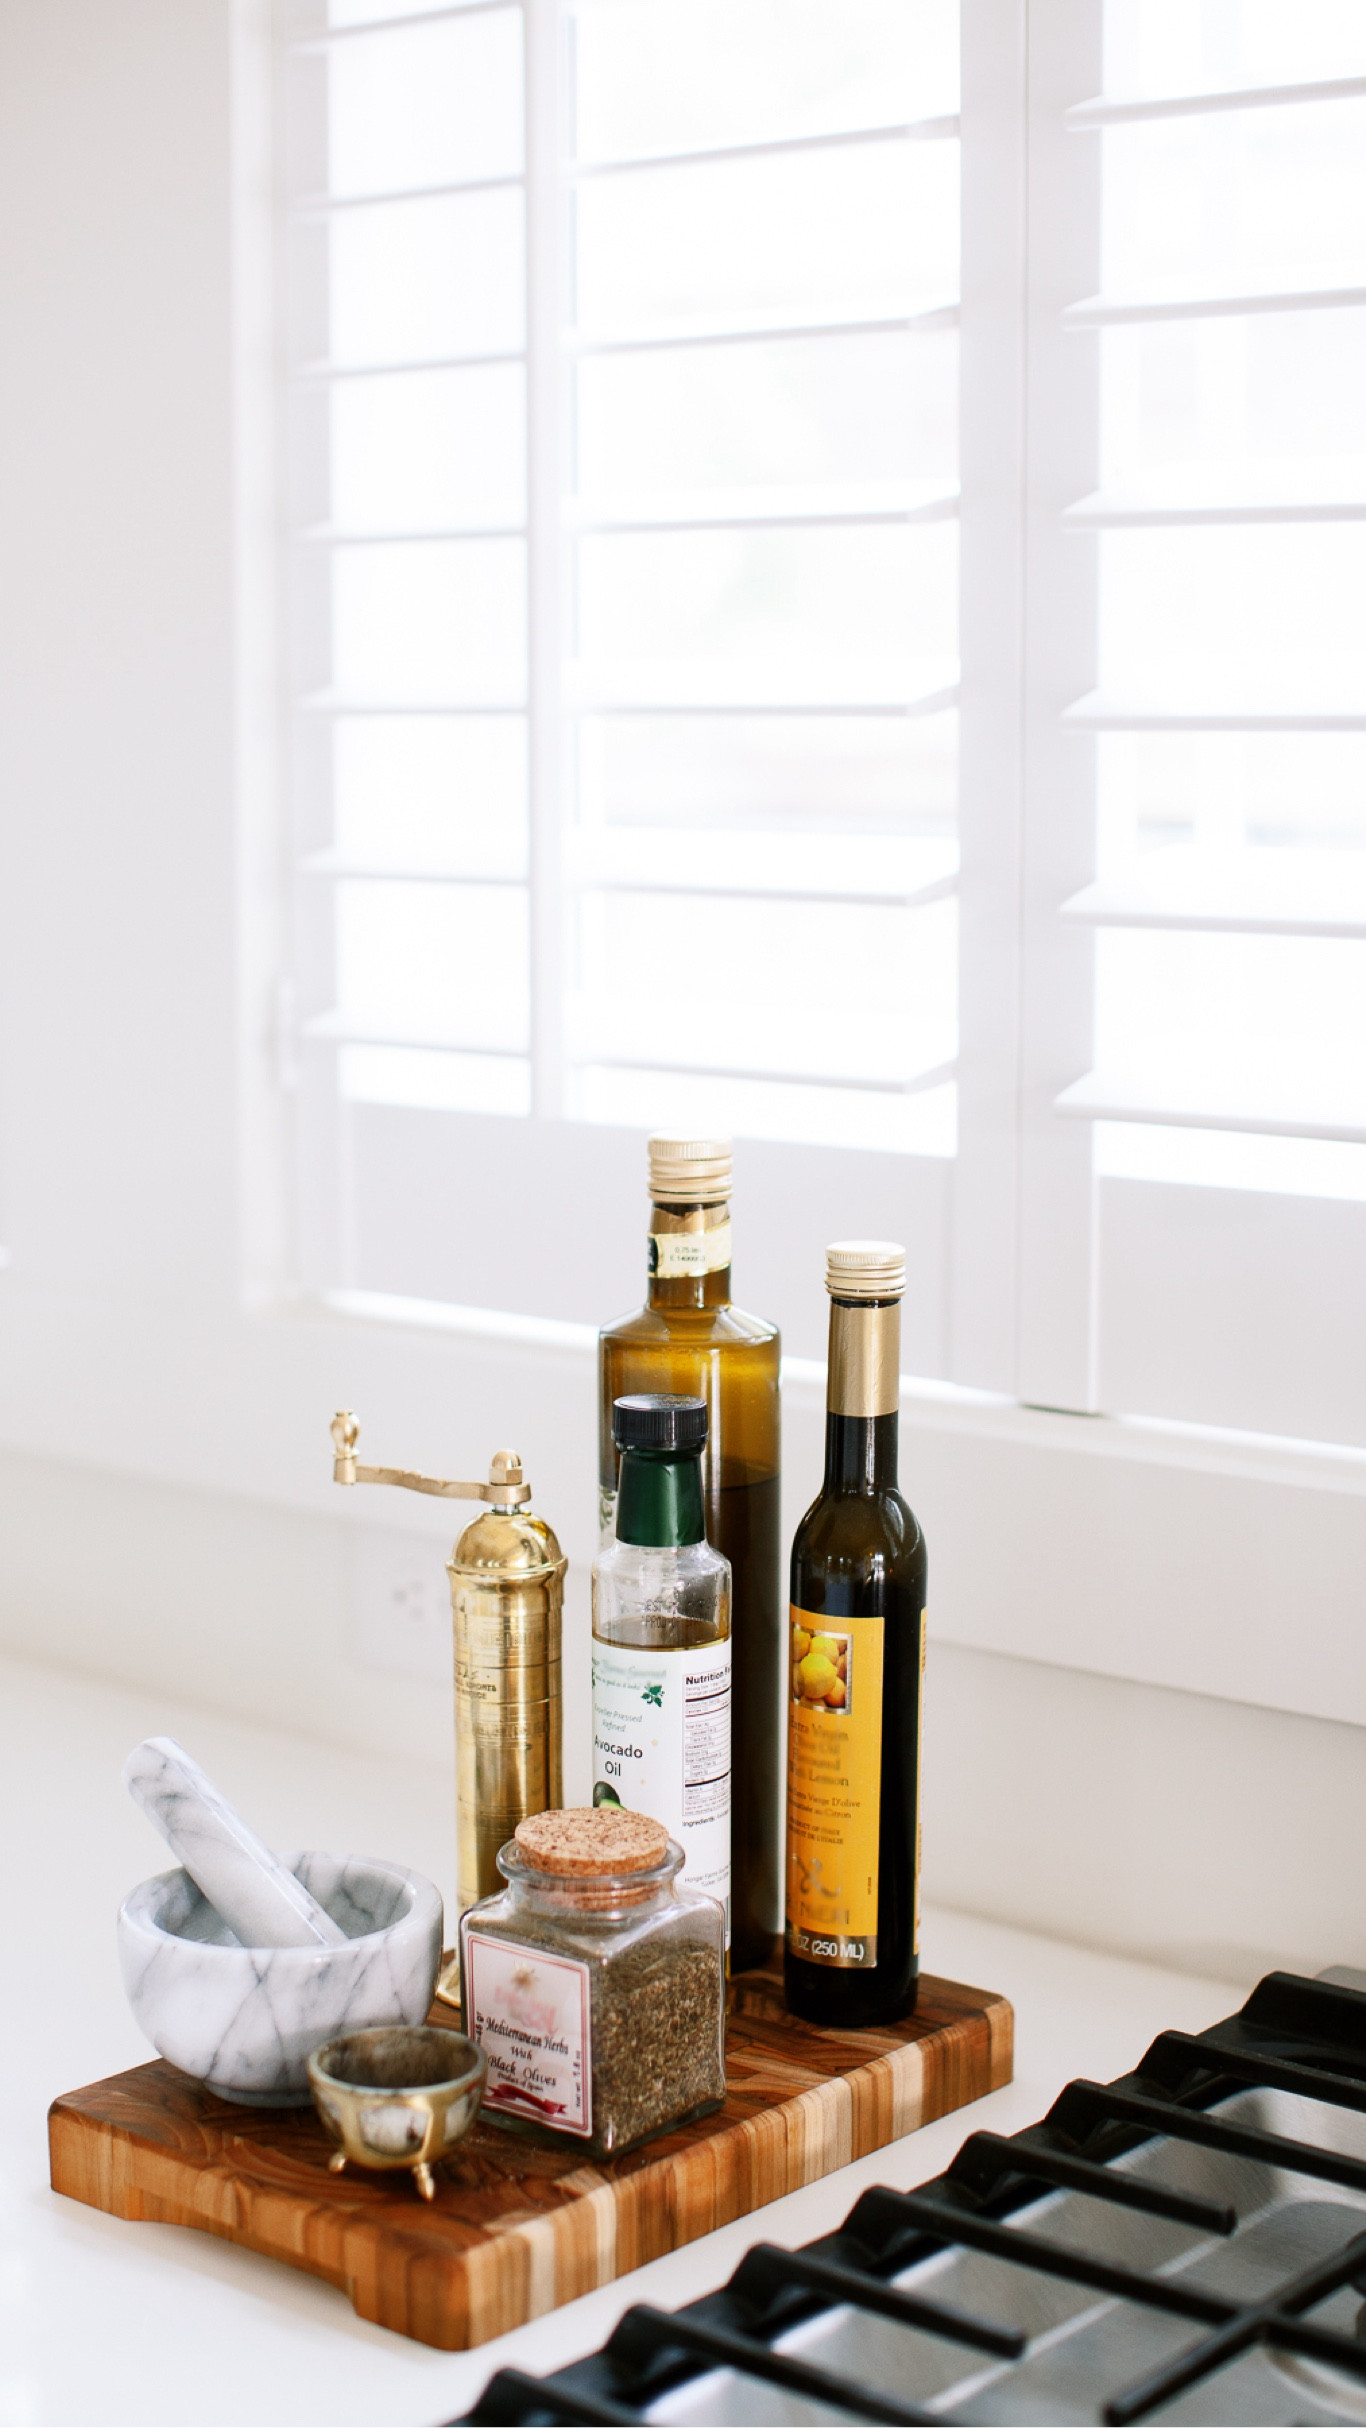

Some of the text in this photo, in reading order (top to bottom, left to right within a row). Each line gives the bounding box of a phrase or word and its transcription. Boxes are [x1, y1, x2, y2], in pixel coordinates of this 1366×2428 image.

[685, 1671, 724, 1685] Nutrition
[594, 1734, 643, 1759] Avocado
[604, 1760, 621, 1777] Oil
[811, 1939, 838, 1957] (250
[840, 1942, 864, 1962] ML)
[486, 2017, 569, 2055] Mediterranean Herbs
[511, 2046, 533, 2061] With
[488, 2055, 557, 2087] Black Olives
